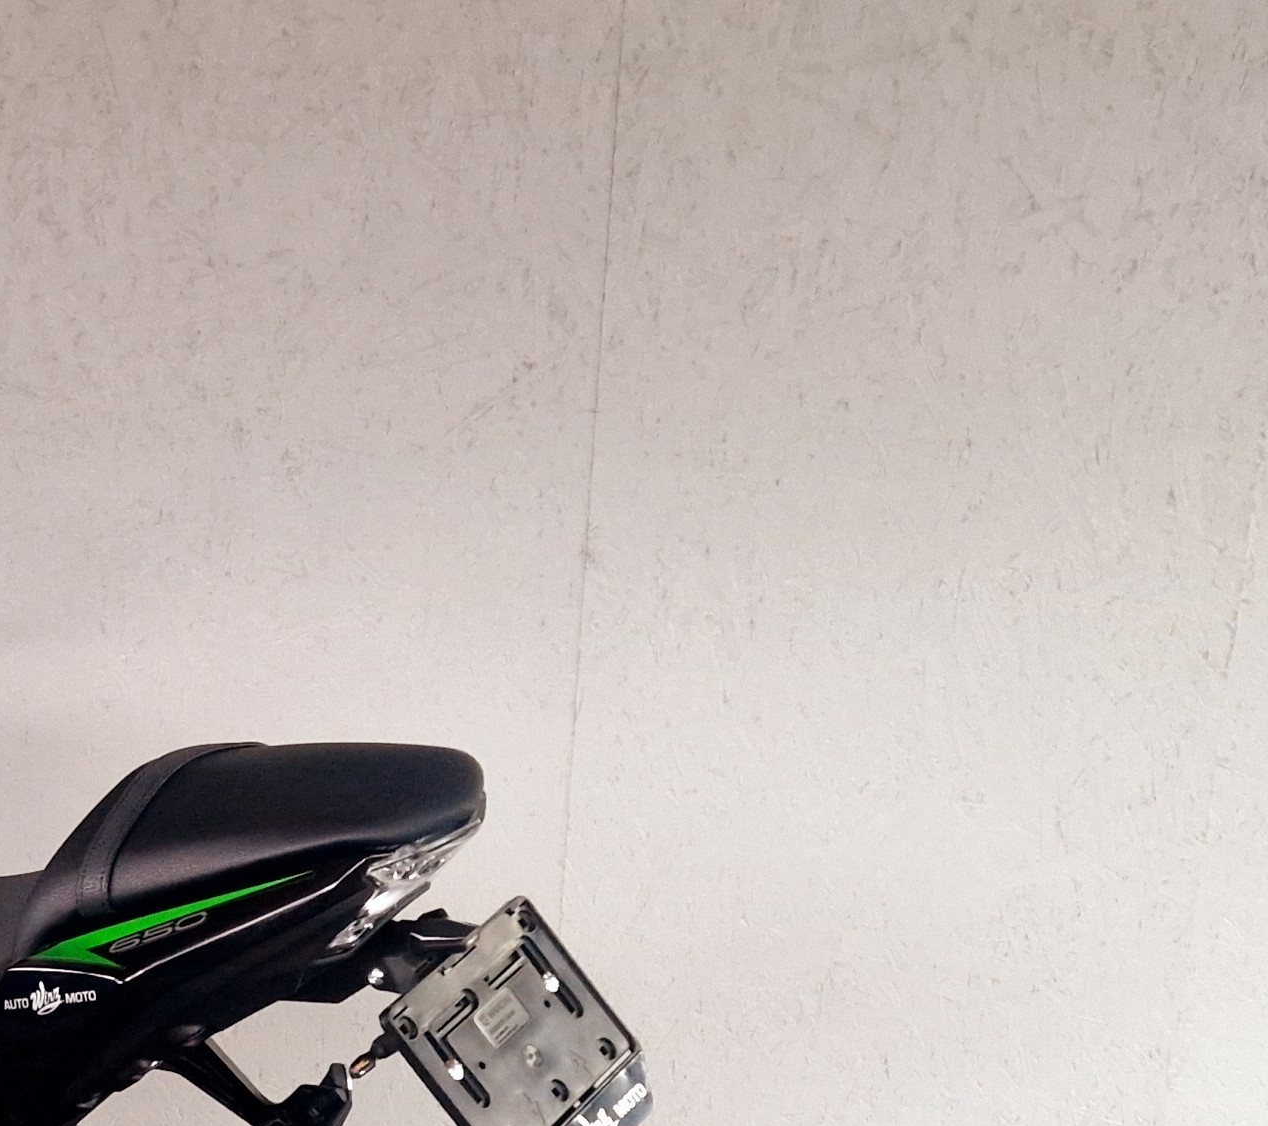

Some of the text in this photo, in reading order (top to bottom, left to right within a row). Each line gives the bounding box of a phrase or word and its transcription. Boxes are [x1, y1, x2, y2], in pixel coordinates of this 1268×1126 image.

[108, 911, 209, 954] 650
[4, 998, 29, 1010] AUTO
[65, 990, 97, 1004] MOTO
[613, 1083, 648, 1118] MOTO
